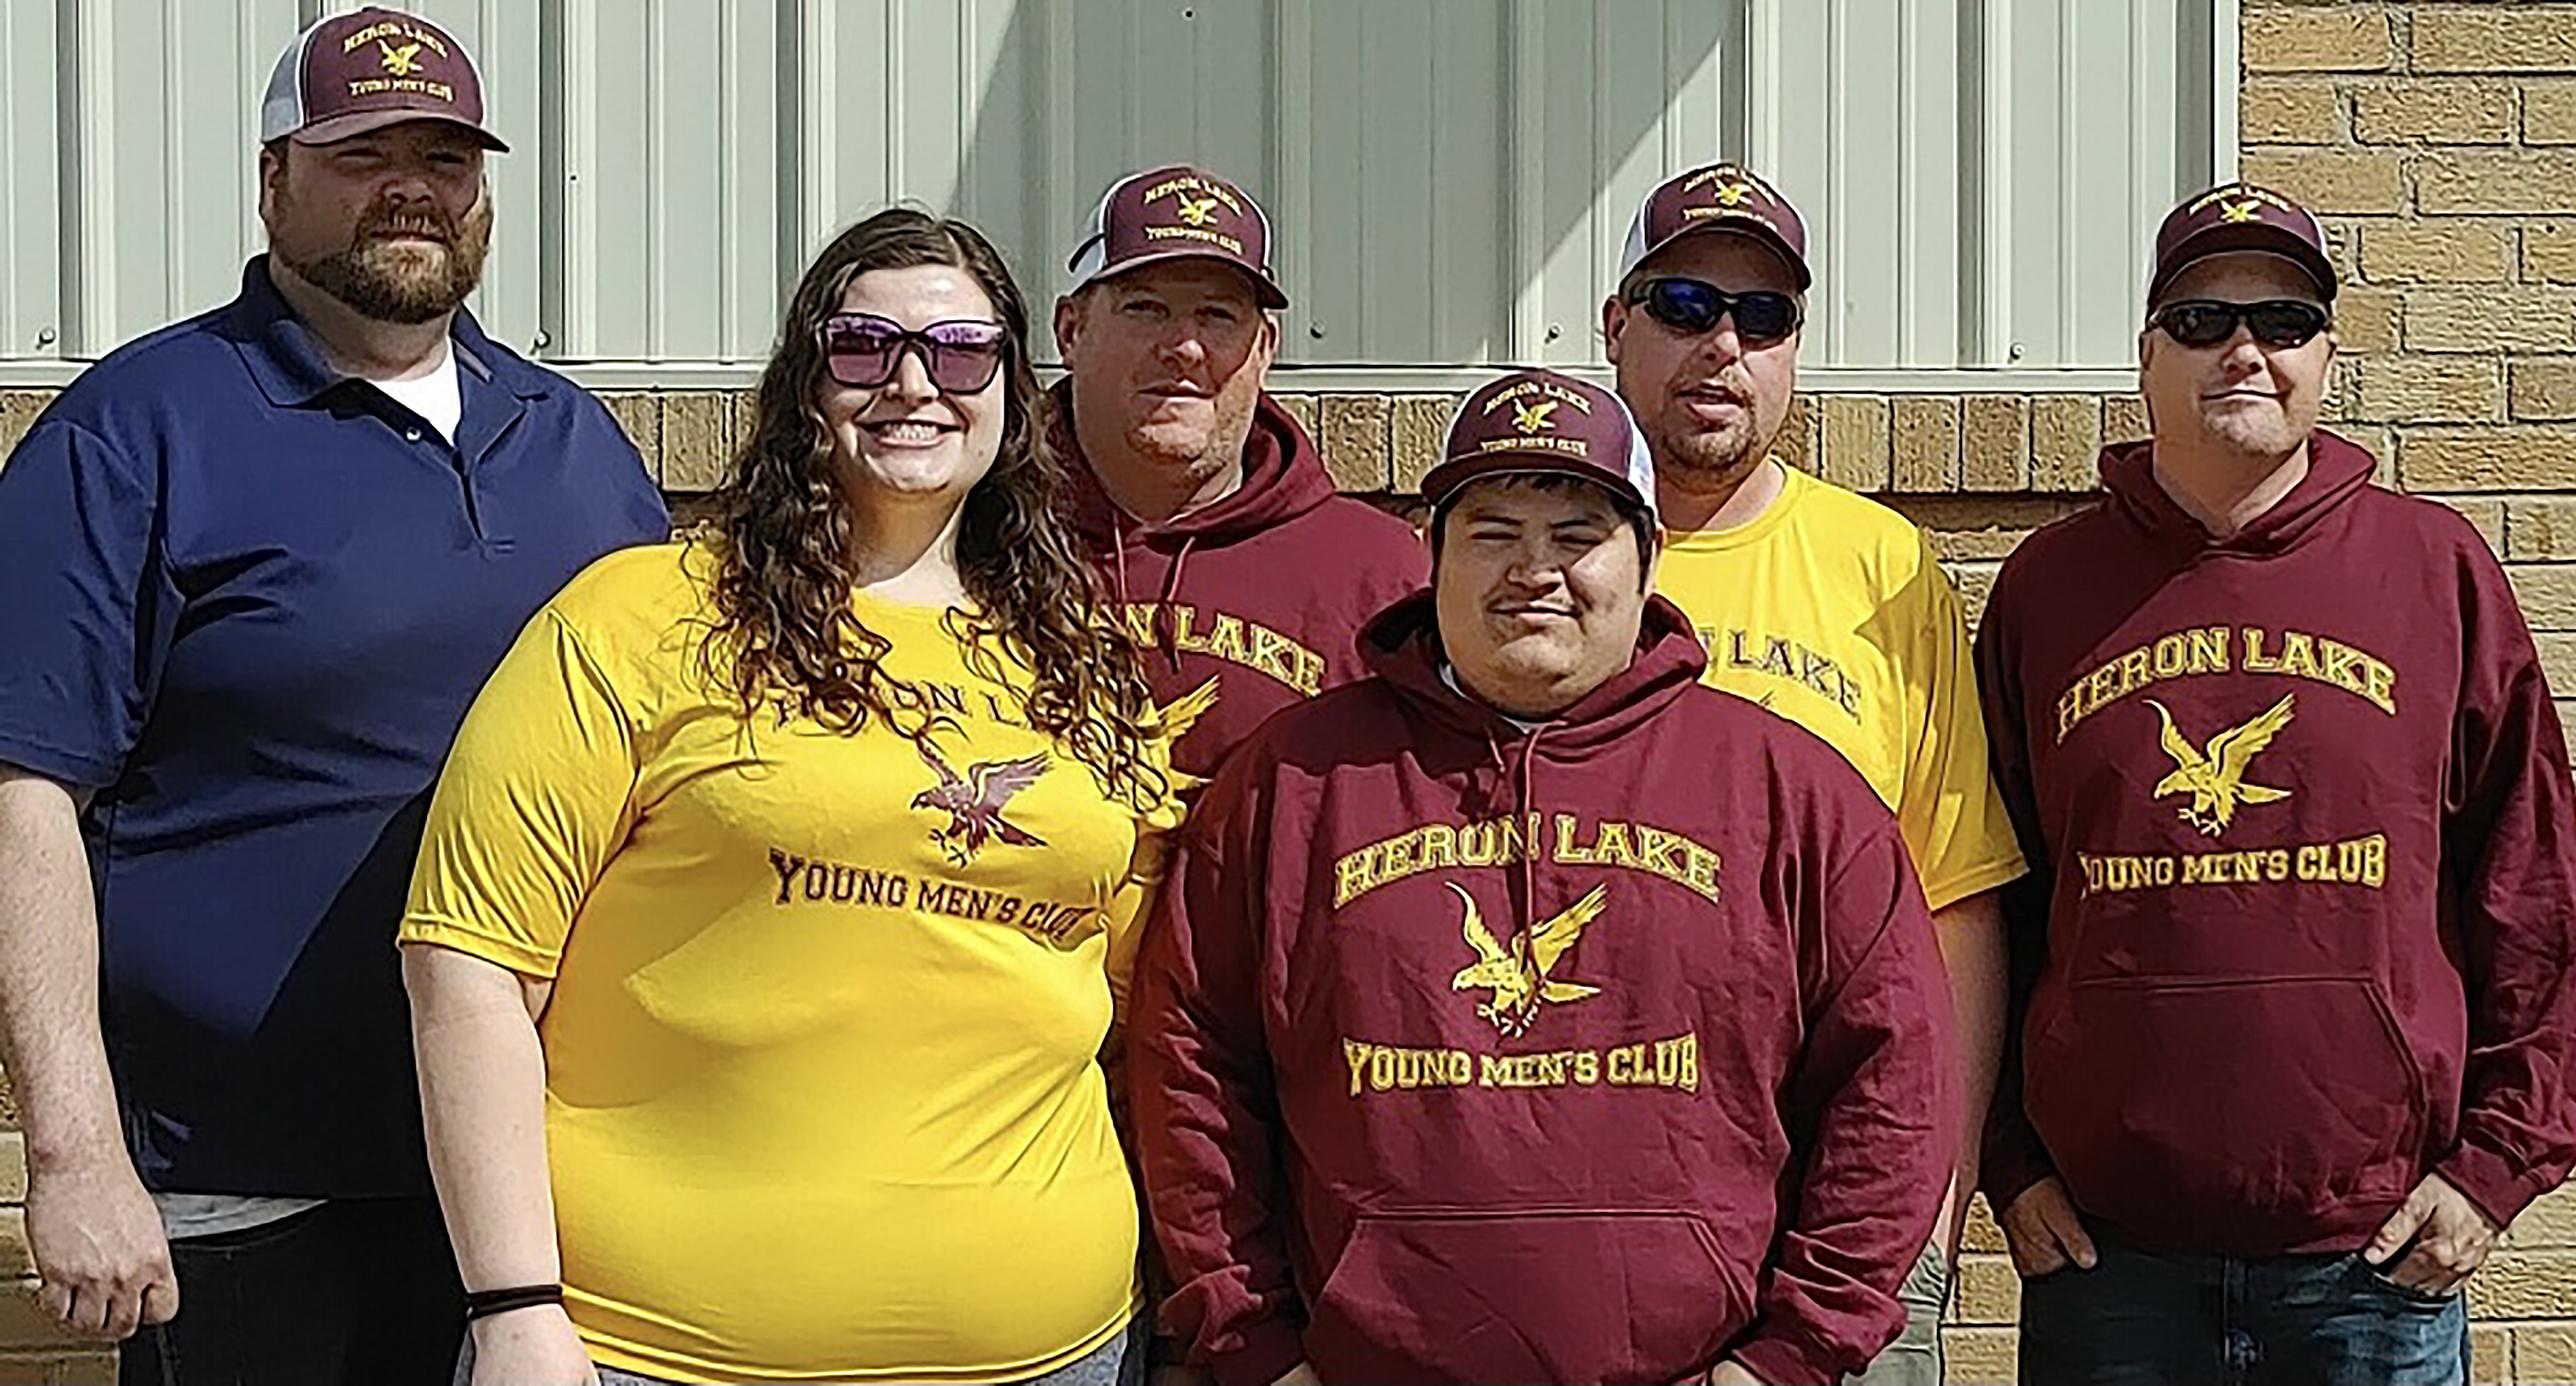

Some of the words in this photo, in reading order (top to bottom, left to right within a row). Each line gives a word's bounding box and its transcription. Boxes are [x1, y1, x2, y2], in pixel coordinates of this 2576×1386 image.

[1173, 604, 1326, 699] LAKE
[1728, 629, 1862, 726] LAKE
[2056, 626, 2231, 747] HERON
[2242, 627, 2397, 716] LAKE
[767, 848, 908, 906] YOUNG
[916, 879, 1021, 924] MEN'S
[1333, 809, 1542, 910] HERON
[1552, 813, 1722, 905] LAKE
[2180, 849, 2290, 885] MEN'S
[2296, 833, 2388, 889] CLUB
[1341, 1035, 1473, 1098] YOUNG
[1478, 1049, 1599, 1088] MEN'S
[1606, 1030, 1699, 1094] CLUB
